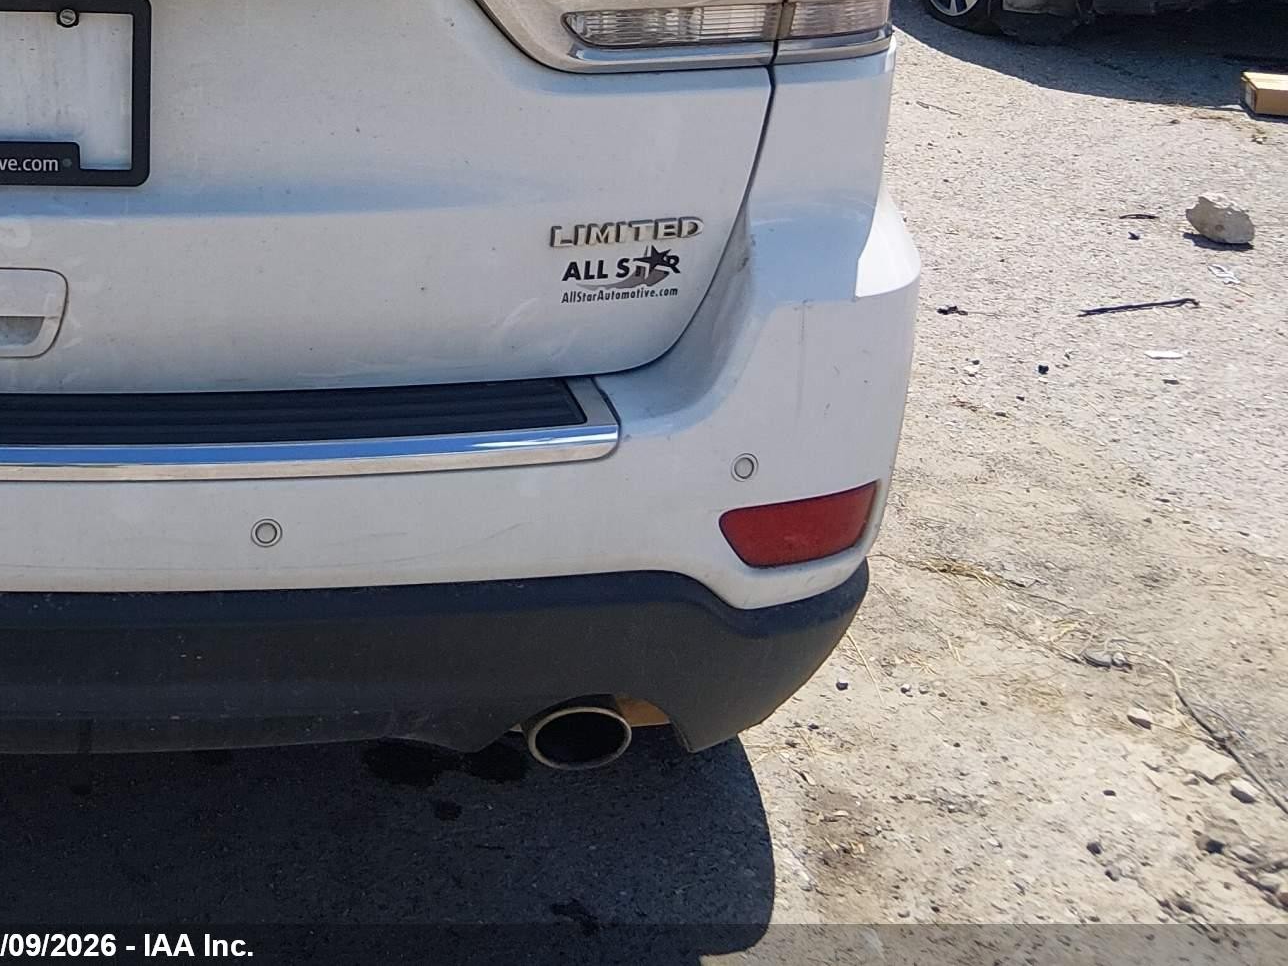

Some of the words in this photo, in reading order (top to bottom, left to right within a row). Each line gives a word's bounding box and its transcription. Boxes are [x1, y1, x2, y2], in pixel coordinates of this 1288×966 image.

[550, 216, 705, 248] LIMITED
[562, 260, 608, 282] ALL
[561, 287, 679, 304] AllStarAutomotive.com
